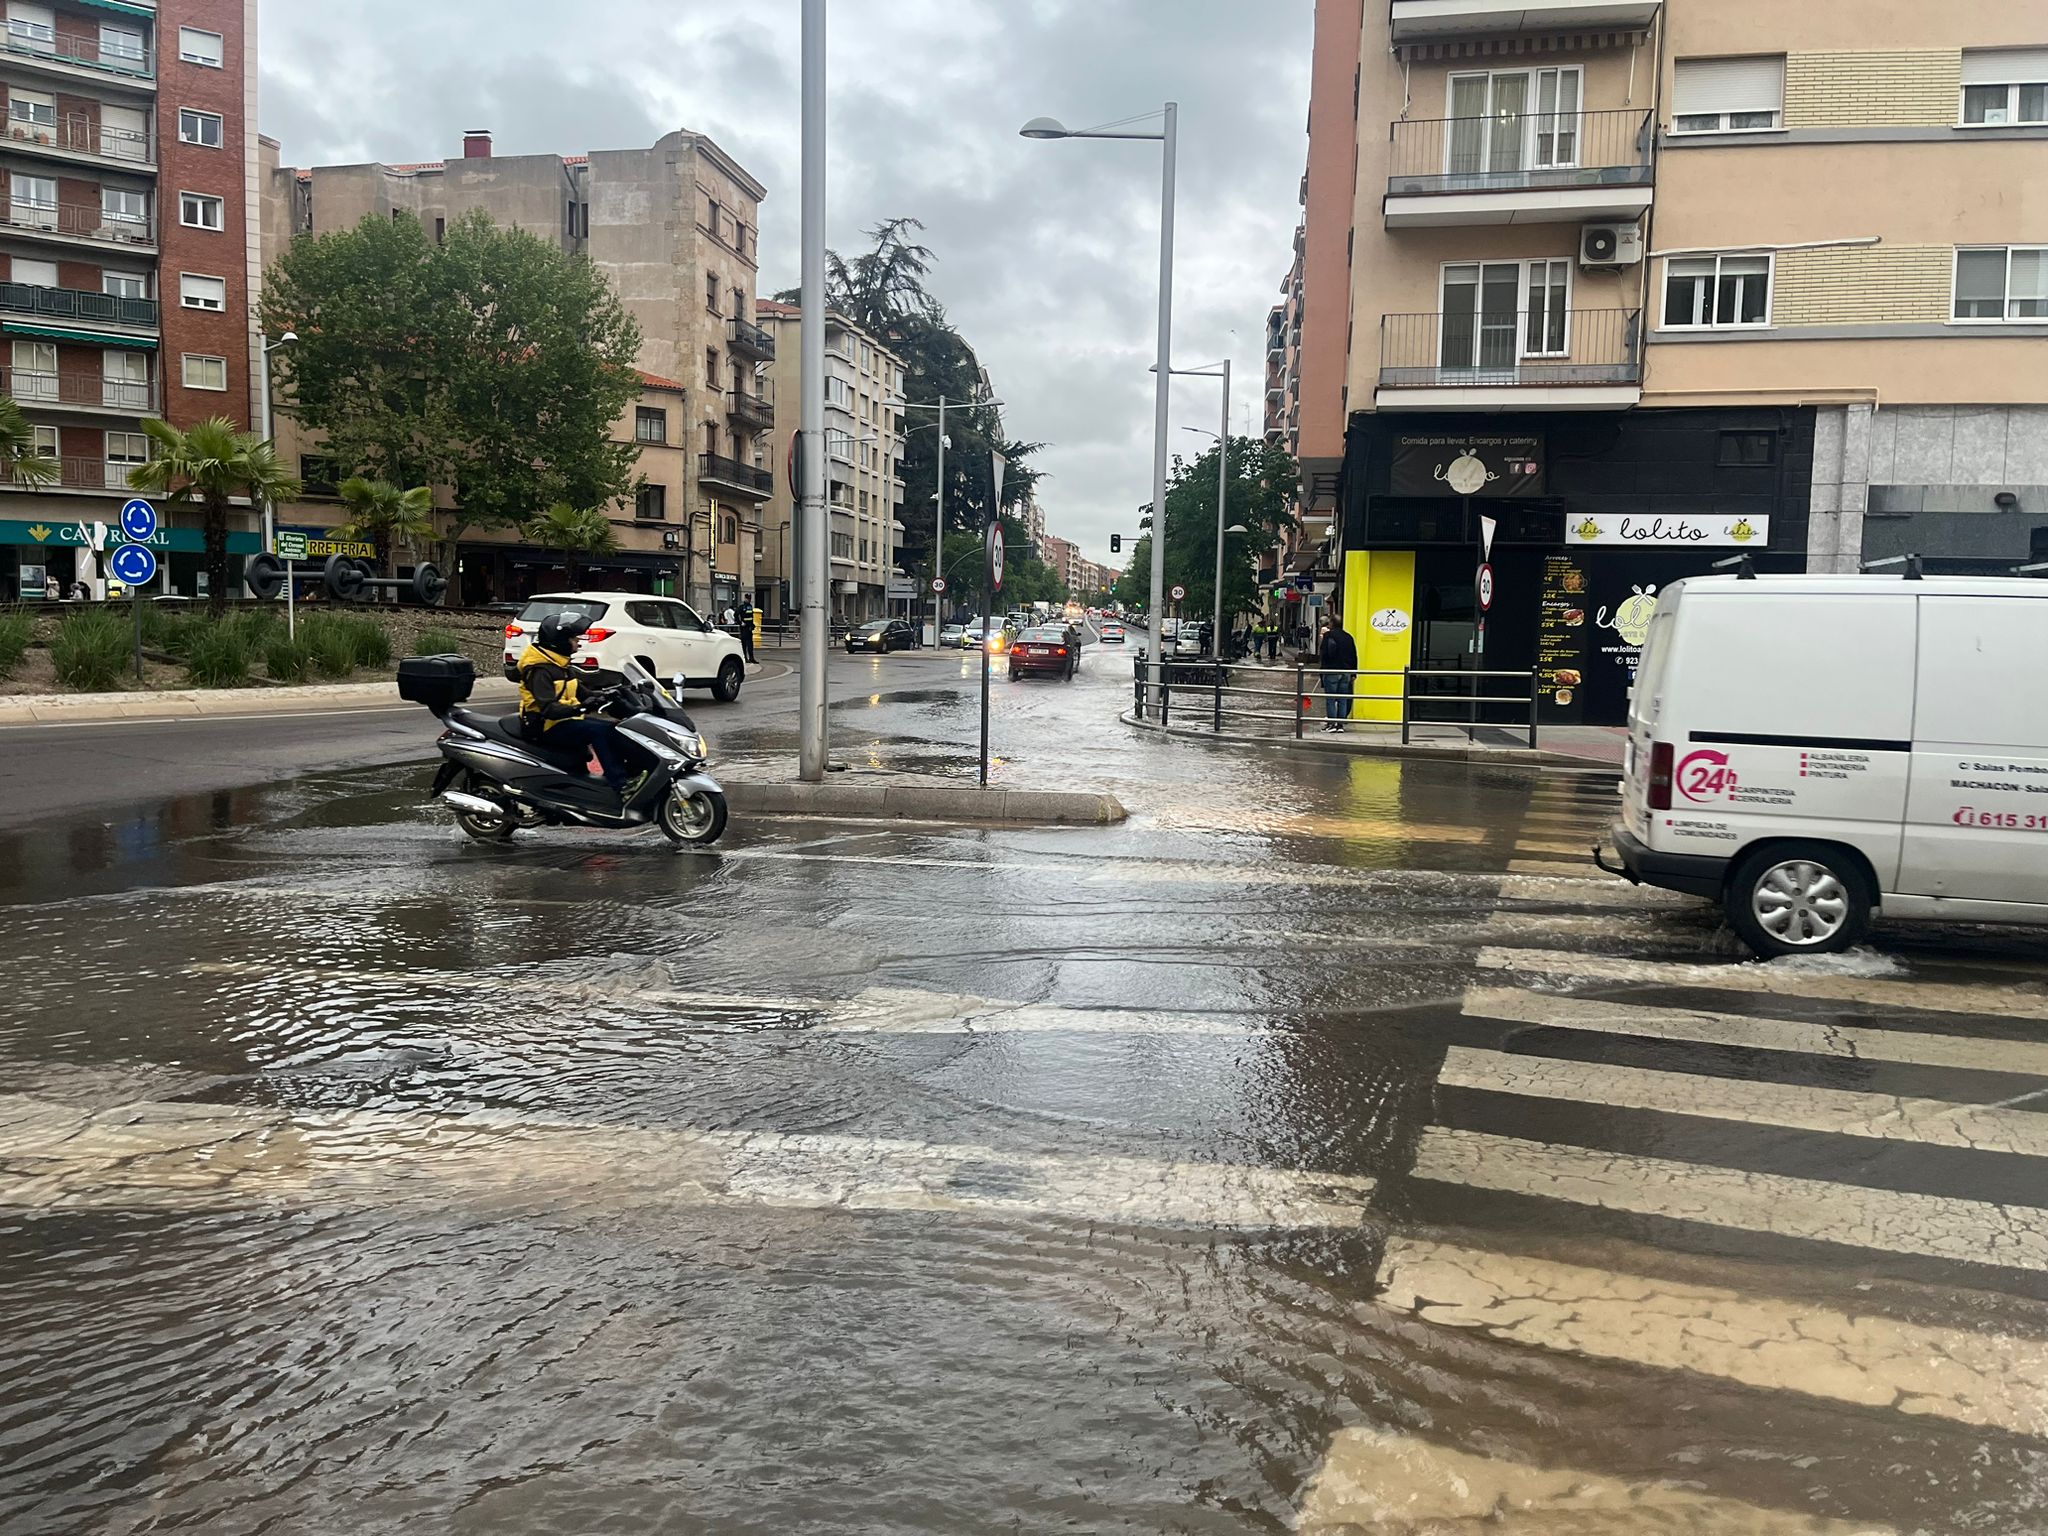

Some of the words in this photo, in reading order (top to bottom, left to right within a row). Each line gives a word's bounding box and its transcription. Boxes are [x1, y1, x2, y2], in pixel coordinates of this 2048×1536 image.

[1401, 437, 1428, 445] Comida
[1430, 438, 1446, 446] para
[1469, 437, 1501, 447] Encargos
[1571, 524, 1605, 534] lolito
[1620, 517, 1709, 540] lolito
[1724, 526, 1760, 536] lolito
[994, 544, 1002, 568] 30
[1482, 579, 1490, 594] 30
[1372, 617, 1408, 628] lolito
[1973, 762, 2004, 771] Salas
[1808, 770, 1849, 779] PINTURA
[1674, 820, 1714, 829] LIMPIEZA
[1979, 812, 2018, 827] 615
[1673, 829, 1738, 840] COMUNIDADES
